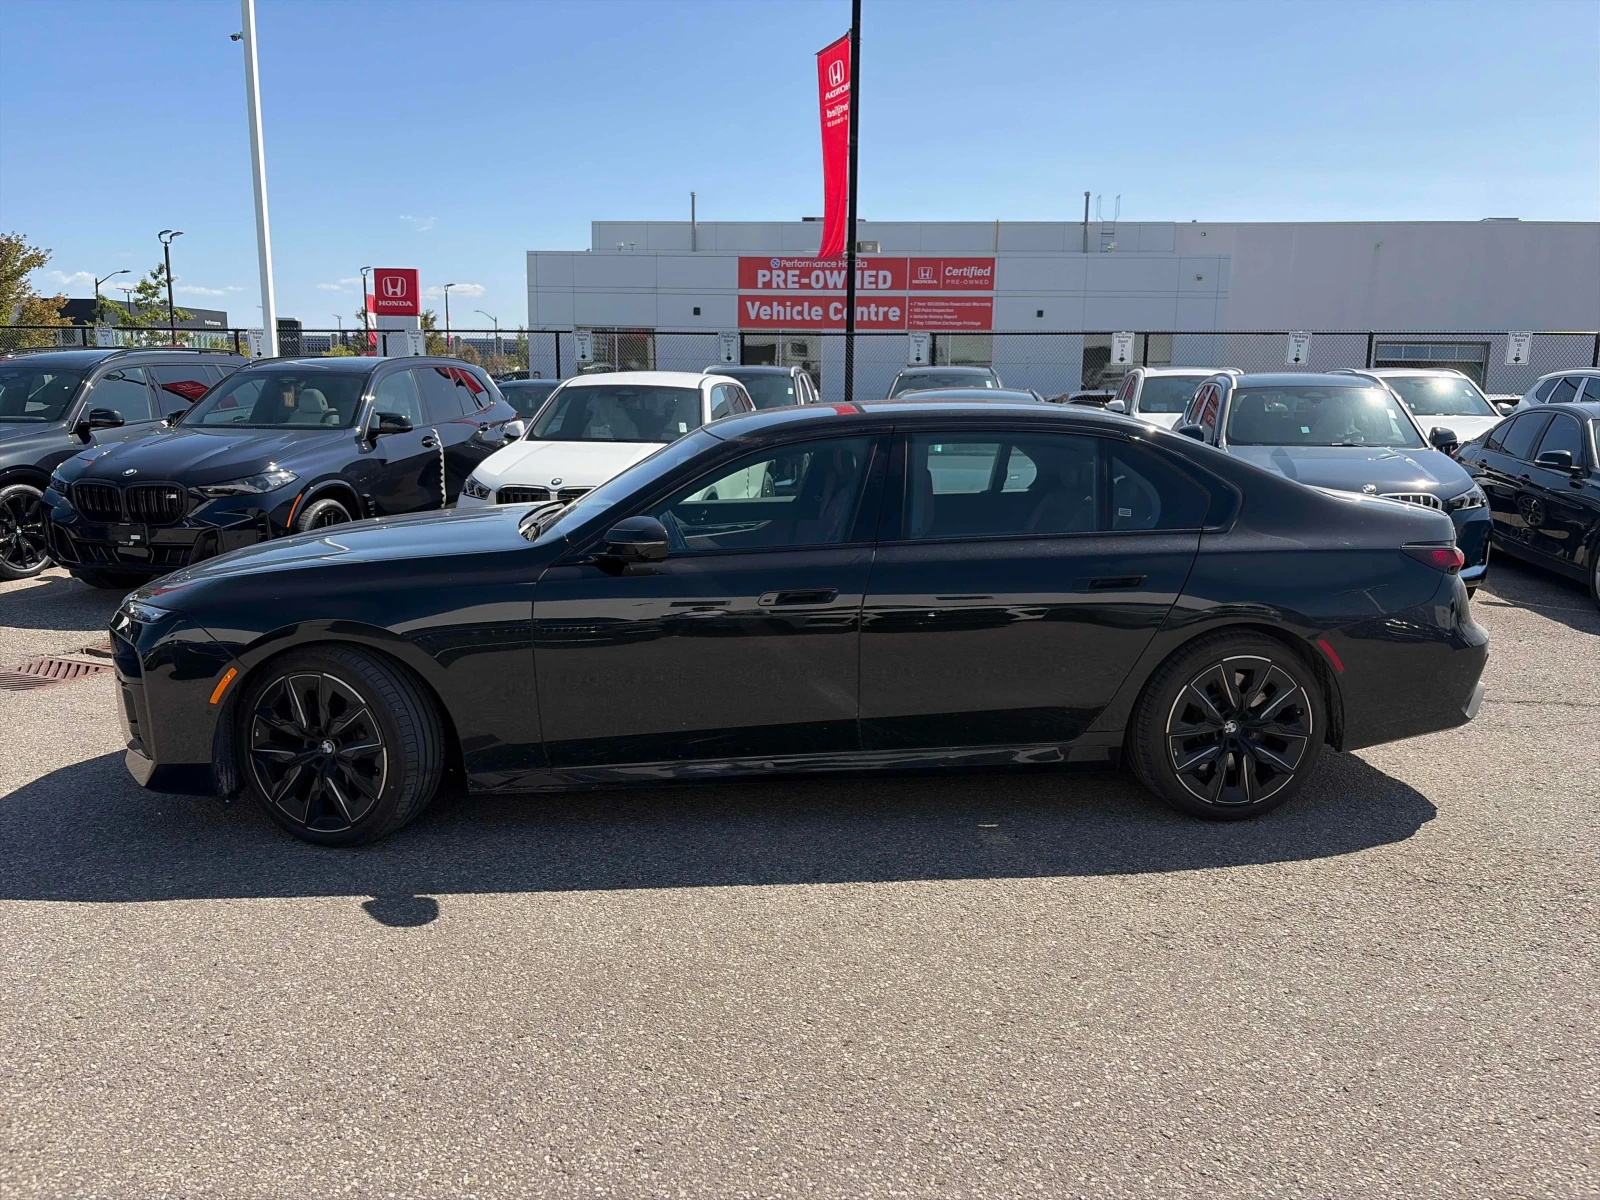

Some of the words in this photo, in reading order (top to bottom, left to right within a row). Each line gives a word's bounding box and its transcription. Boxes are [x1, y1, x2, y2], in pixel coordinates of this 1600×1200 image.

[781, 259, 837, 268] Performance
[838, 259, 868, 268] Hoda
[945, 266, 991, 278] Certified
[746, 301, 823, 320] Vehicle
